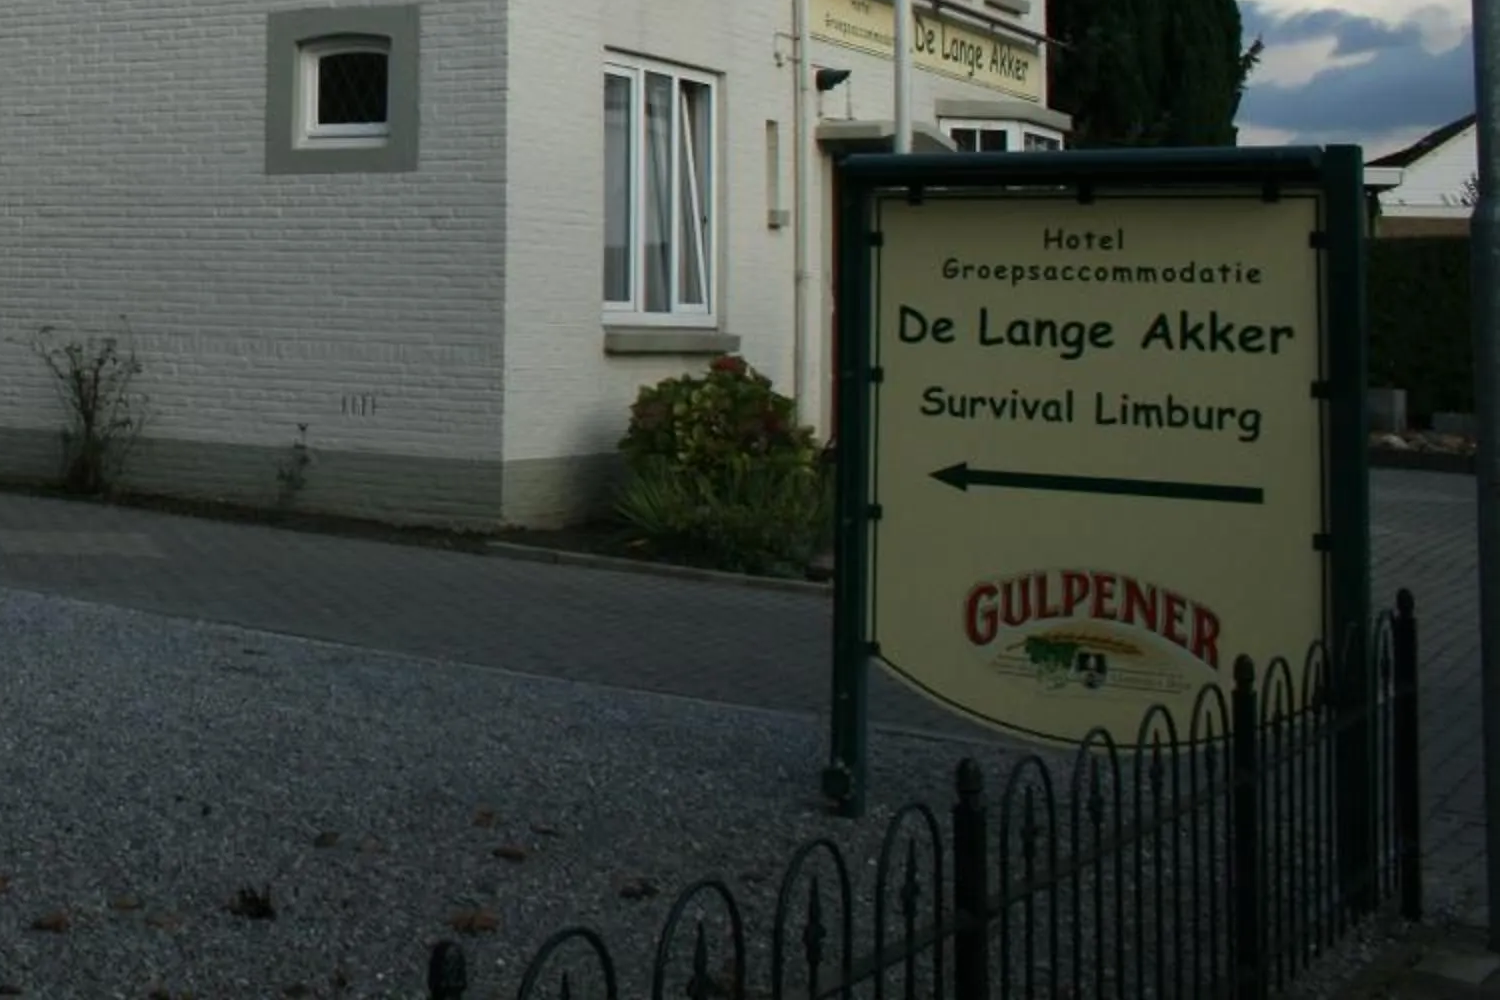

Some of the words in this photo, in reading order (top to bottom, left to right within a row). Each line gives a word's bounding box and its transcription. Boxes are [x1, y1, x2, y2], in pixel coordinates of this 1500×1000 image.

[914, 10, 935, 53] De
[941, 21, 984, 77] Lange
[989, 43, 1029, 82] Akker
[1043, 229, 1125, 251] Hotel
[942, 258, 1262, 287] Groepsaccommodatie
[899, 305, 955, 344] De
[979, 307, 1115, 360] Lange
[1141, 311, 1295, 354] Akker
[920, 387, 1074, 422] Survival
[1095, 393, 1263, 443] Limburg
[963, 569, 1221, 671] GULPENER
